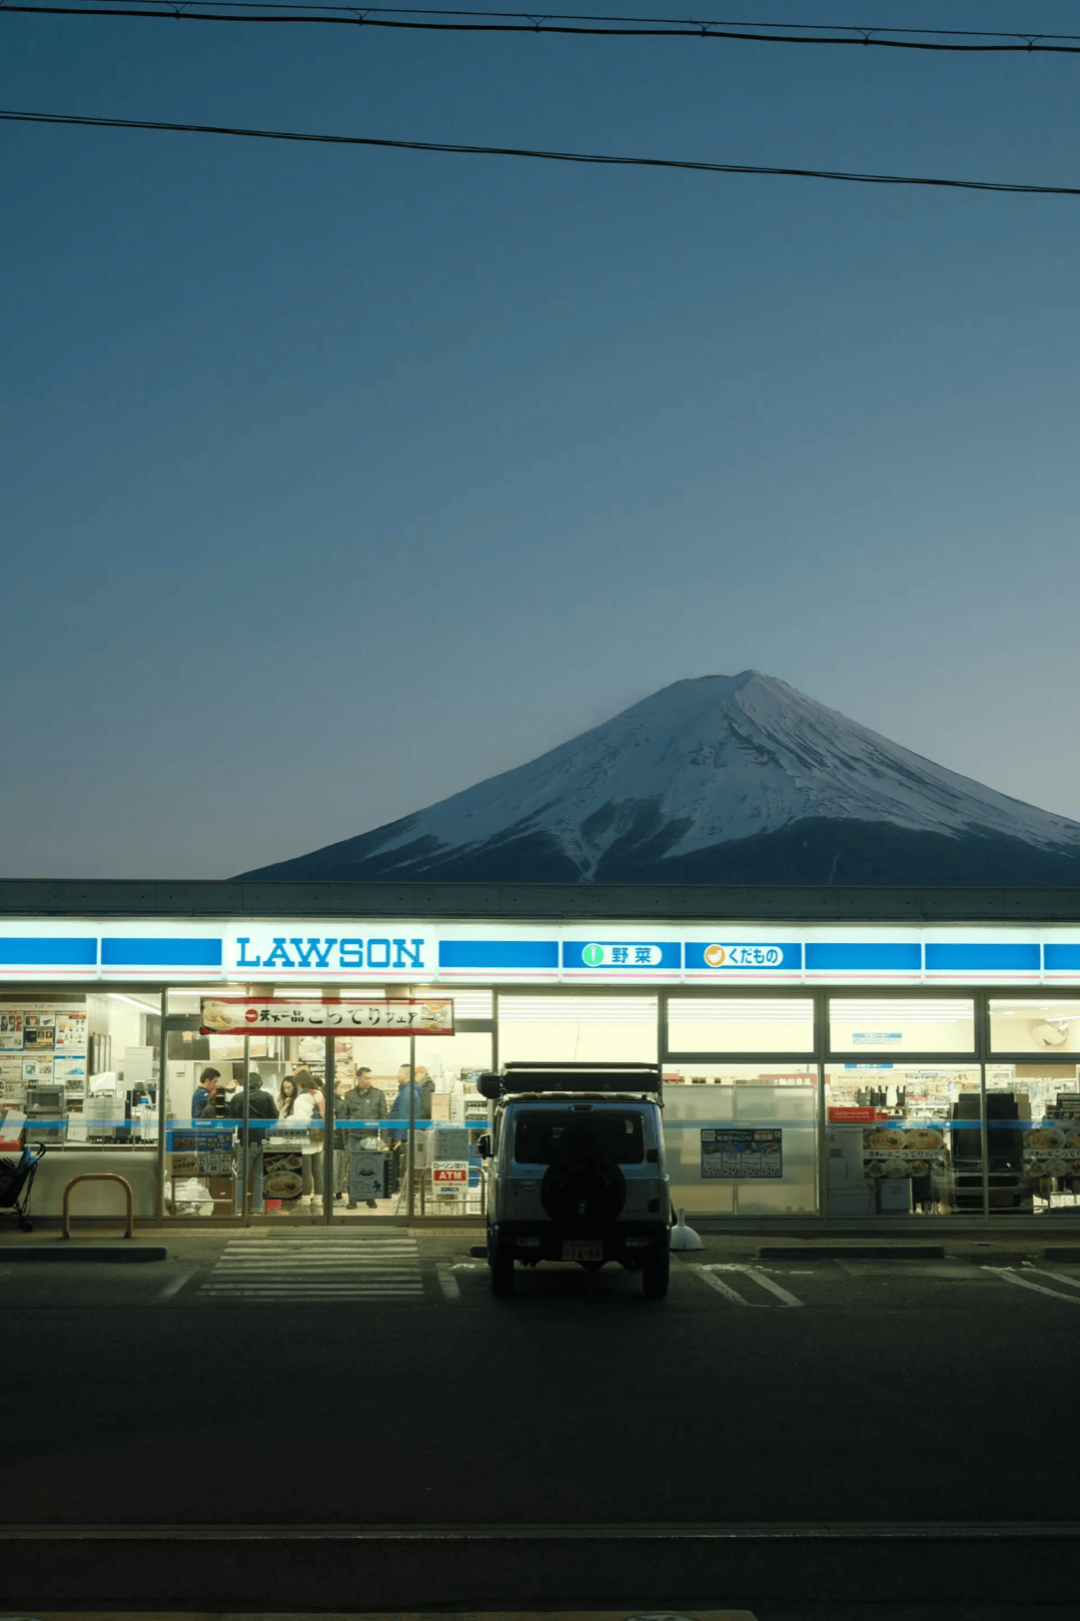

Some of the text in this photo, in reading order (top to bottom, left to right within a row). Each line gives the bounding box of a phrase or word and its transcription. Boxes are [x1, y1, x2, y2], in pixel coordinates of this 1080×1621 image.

[236, 937, 425, 968] LAWSON
[611, 946, 652, 963] 野菜
[728, 944, 778, 966] くだもの
[439, 1171, 462, 1179] ATM
